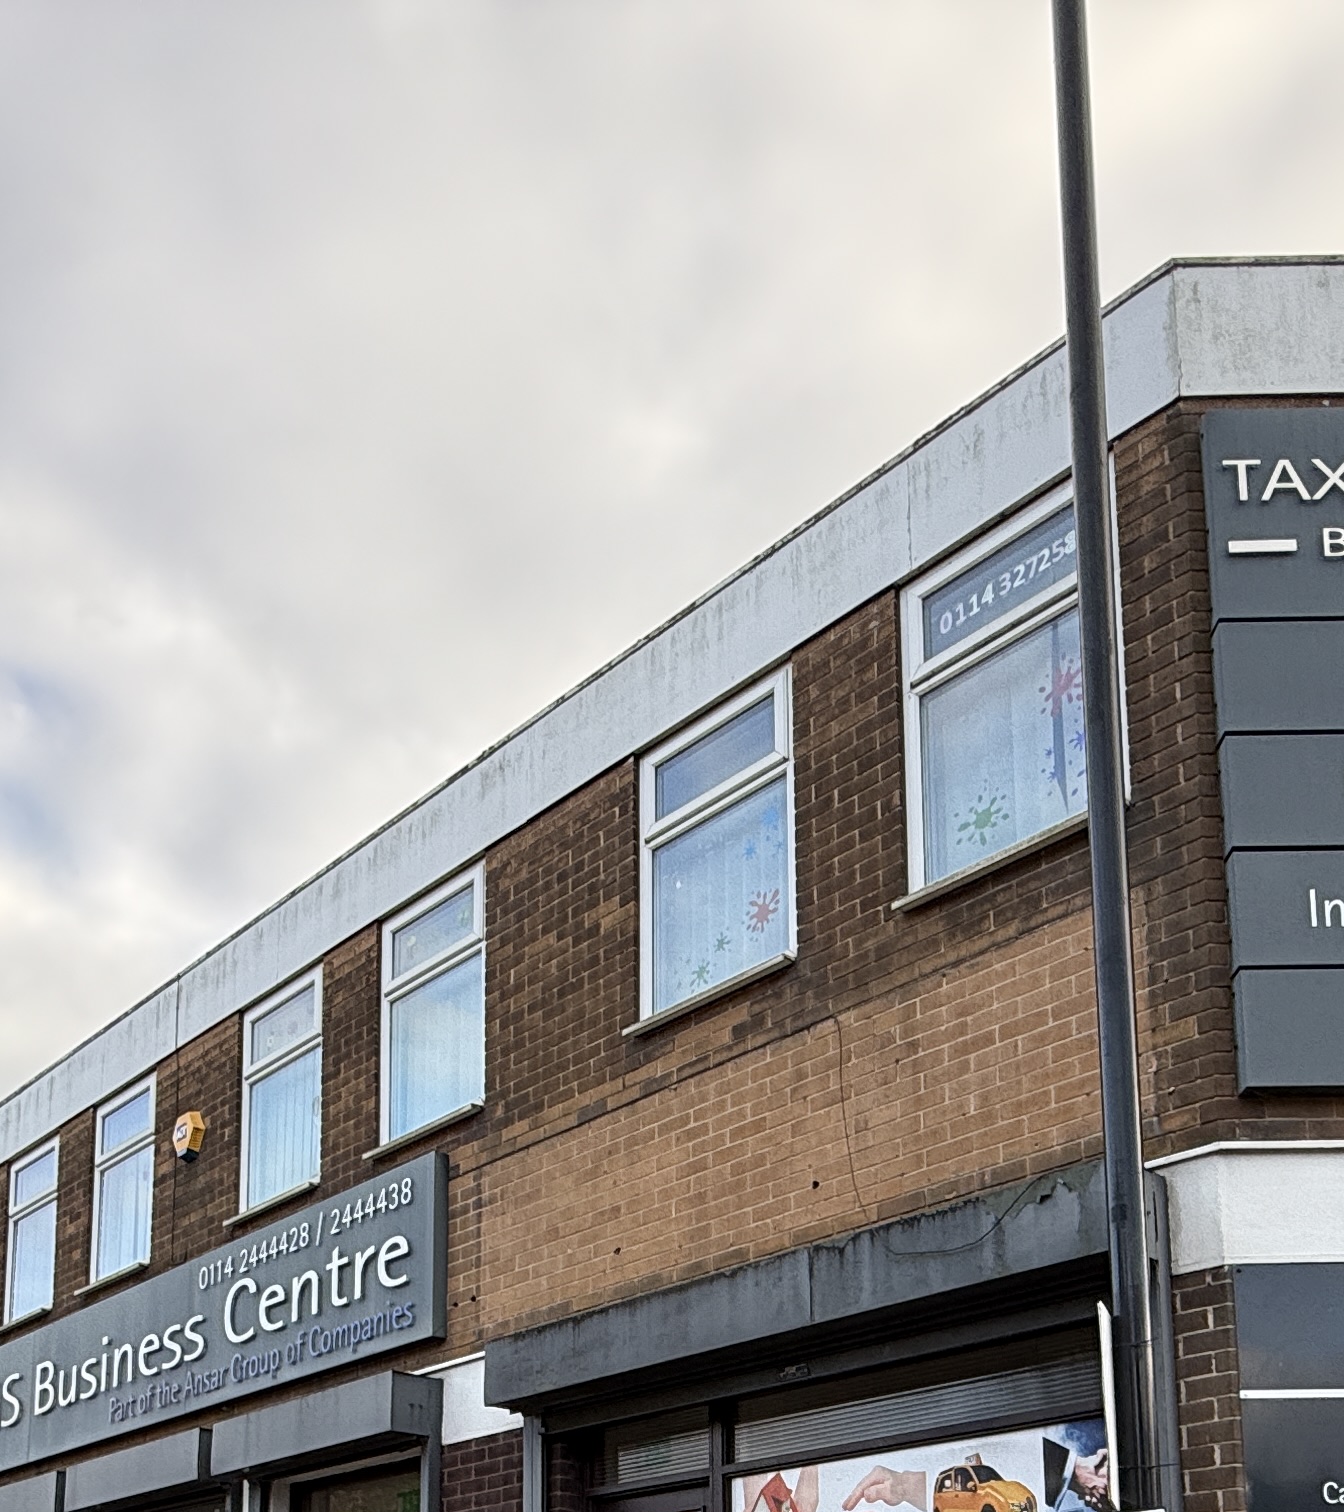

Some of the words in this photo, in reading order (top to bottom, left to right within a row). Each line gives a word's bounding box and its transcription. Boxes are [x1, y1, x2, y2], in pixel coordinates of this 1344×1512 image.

[939, 582, 994, 635] 0114
[198, 1255, 234, 1290] 0114
[240, 1227, 309, 1273] 2444428
[316, 1211, 324, 1246] /
[329, 1177, 413, 1235] 2444438
[34, 1313, 206, 1416] Business
[224, 1235, 410, 1345] Centre
[108, 1392, 137, 1423] Part
[138, 1384, 156, 1414] of
[156, 1380, 181, 1409] the
[183, 1367, 230, 1401] Ansar
[230, 1346, 281, 1387] Group
[285, 1333, 307, 1364] of
[307, 1301, 415, 1357] Companies
